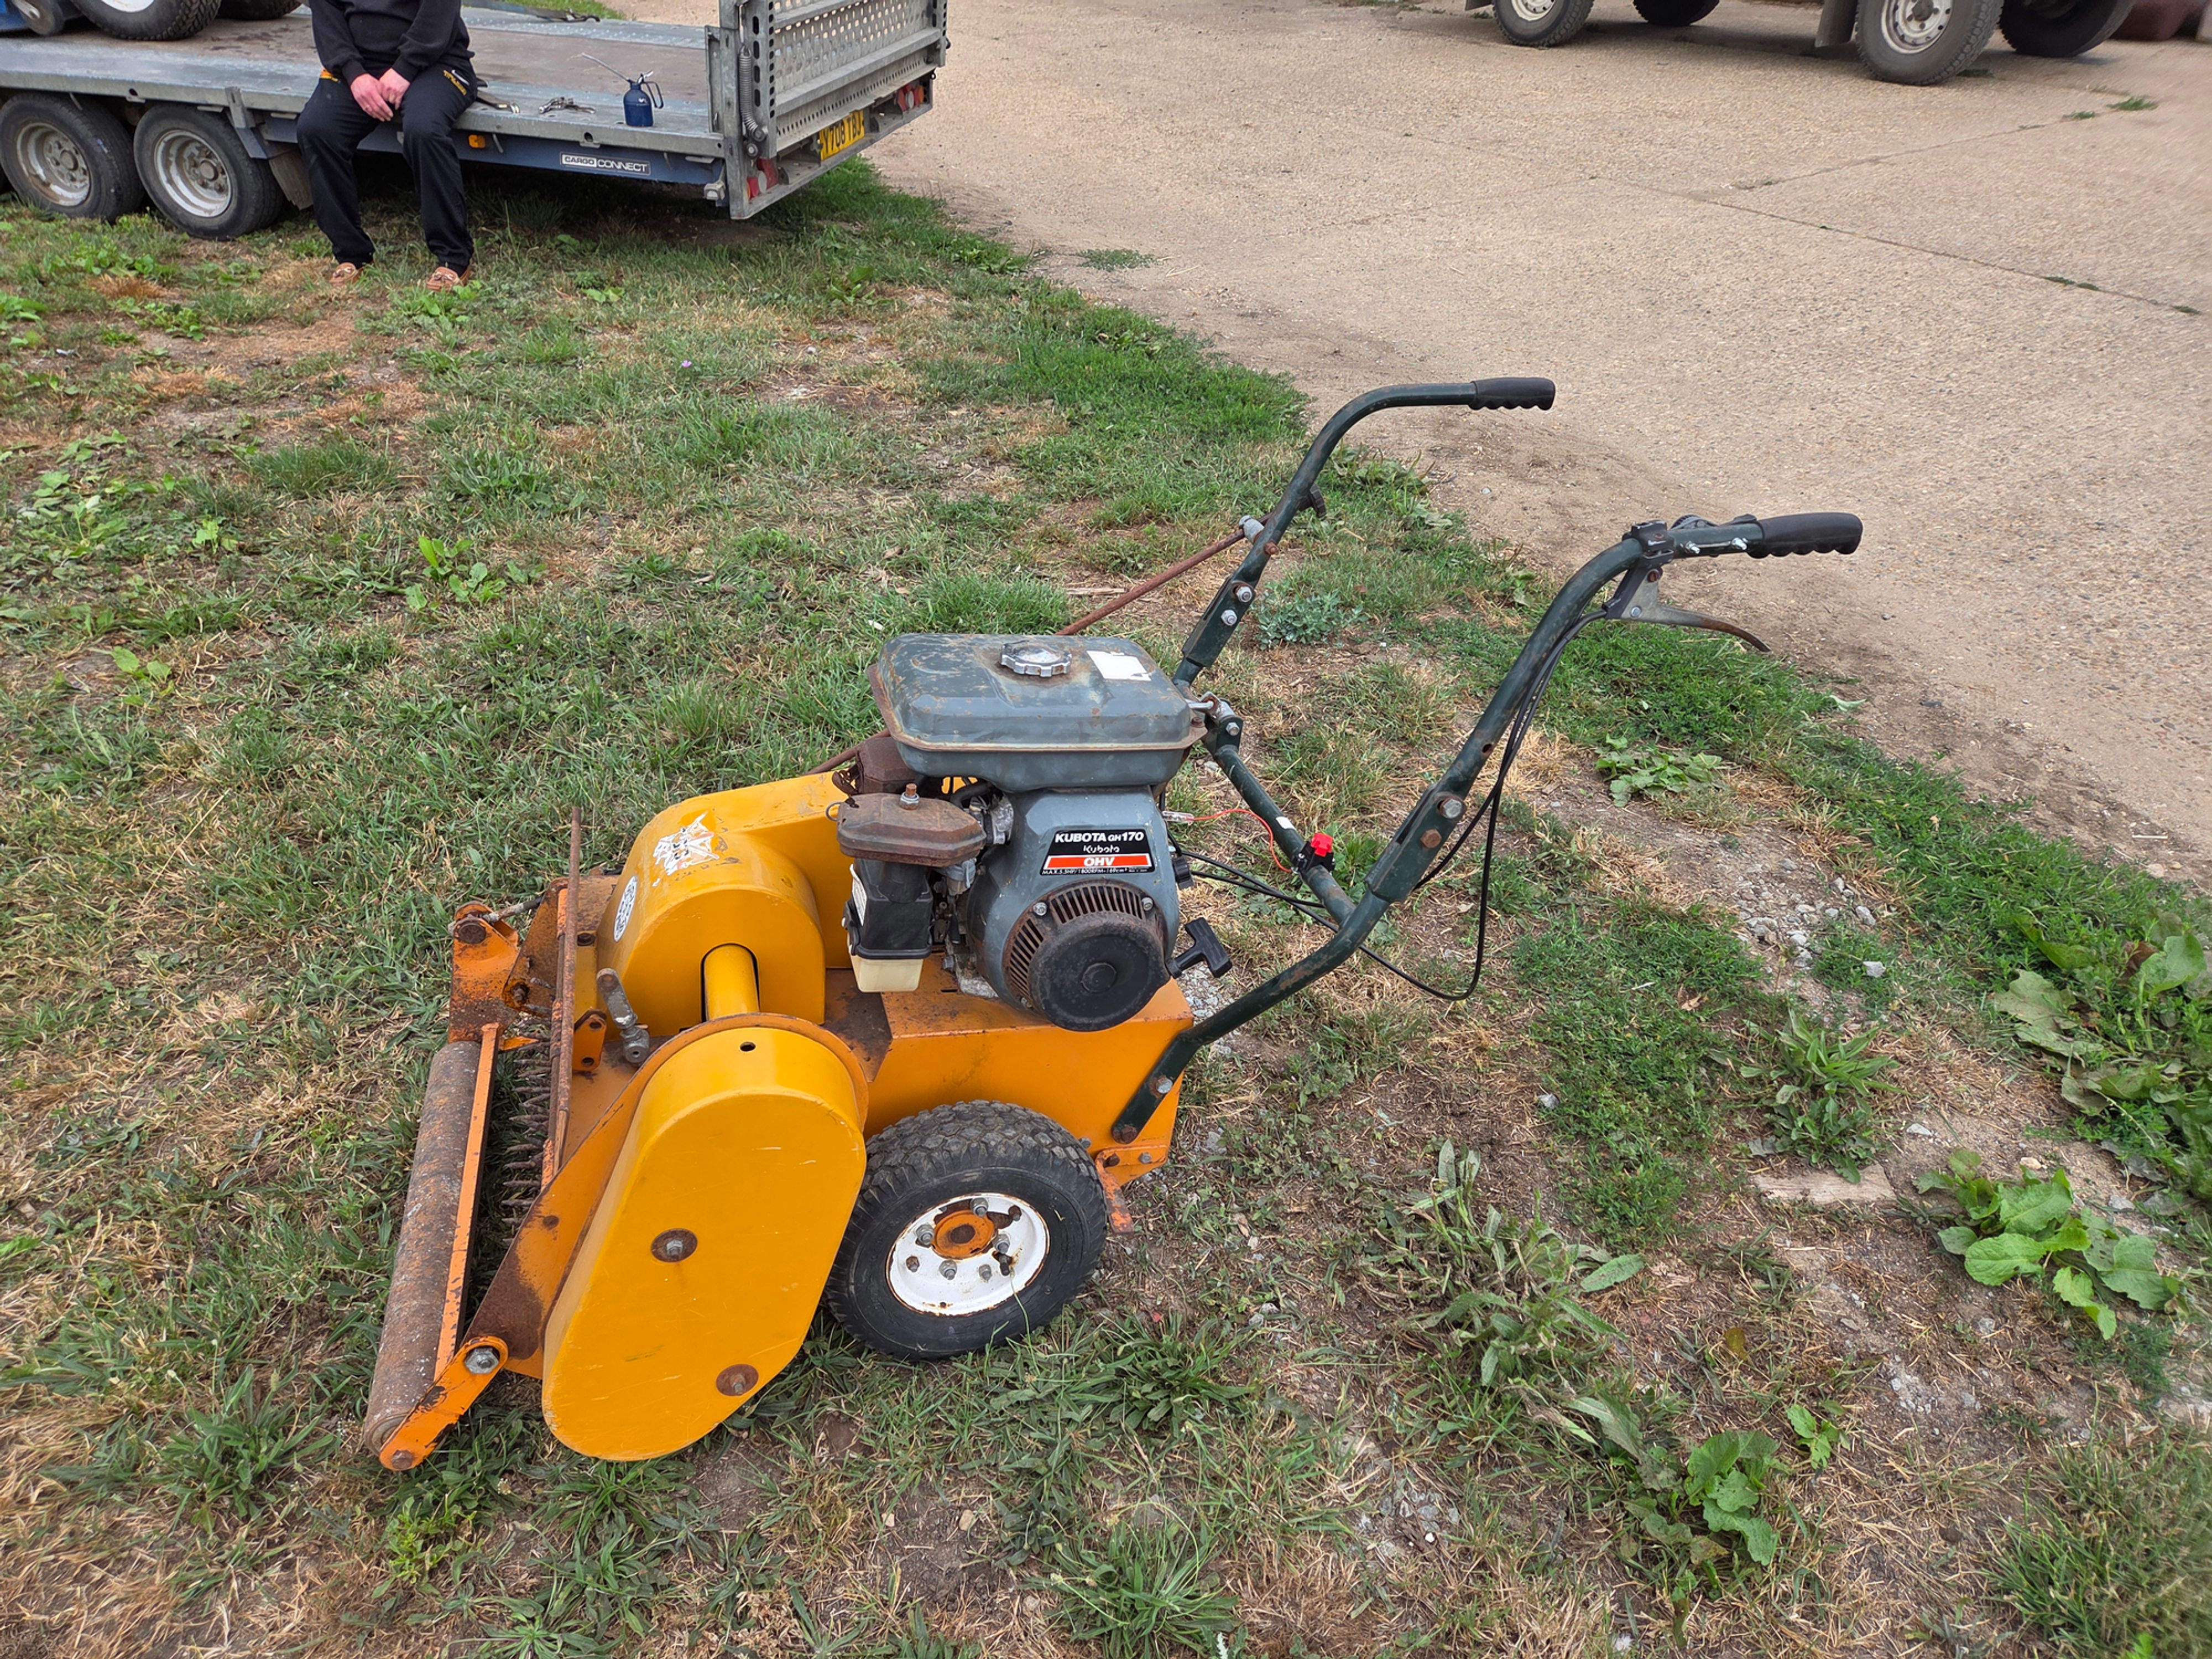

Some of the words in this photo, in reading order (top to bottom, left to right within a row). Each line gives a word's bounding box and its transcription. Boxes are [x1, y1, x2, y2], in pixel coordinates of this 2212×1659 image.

[564, 156, 594, 165] CARGO
[597, 159, 648, 172] CONNECT
[1055, 832, 1107, 843] KUBOTA
[1108, 831, 1144, 842] GH170
[1083, 844, 1120, 853] Kubota
[1083, 857, 1115, 867] OHV
